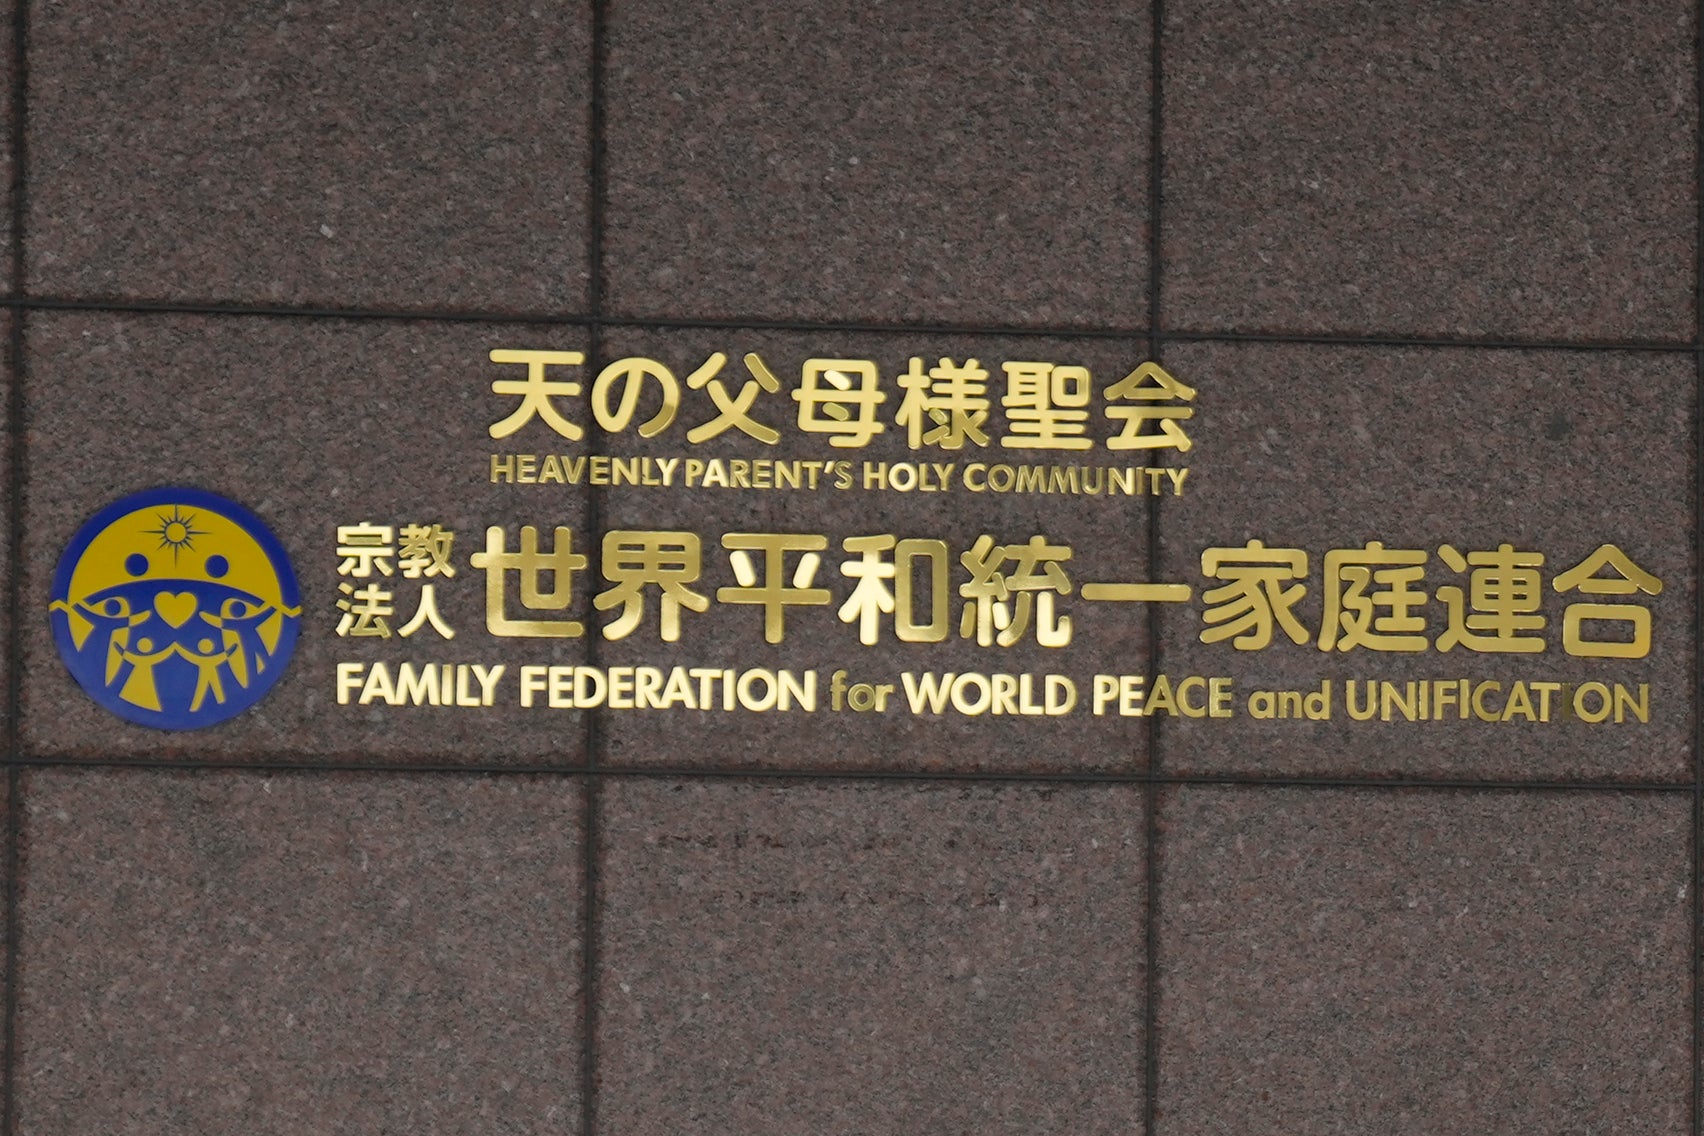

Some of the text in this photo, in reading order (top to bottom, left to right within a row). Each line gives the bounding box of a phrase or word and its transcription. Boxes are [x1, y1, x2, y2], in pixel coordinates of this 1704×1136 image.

[488, 347, 1197, 453] 天の父母様聖会
[489, 454, 1190, 497] HEAVENLY PARENT'S HOLY COMMUNITY
[335, 522, 457, 580] 宗教
[335, 583, 457, 642] 法人
[469, 523, 1664, 660] 世界平和統一家庭連合
[335, 662, 1650, 724] FAMILY FEDERATION for WORLD PEACE and UNIFICATION
